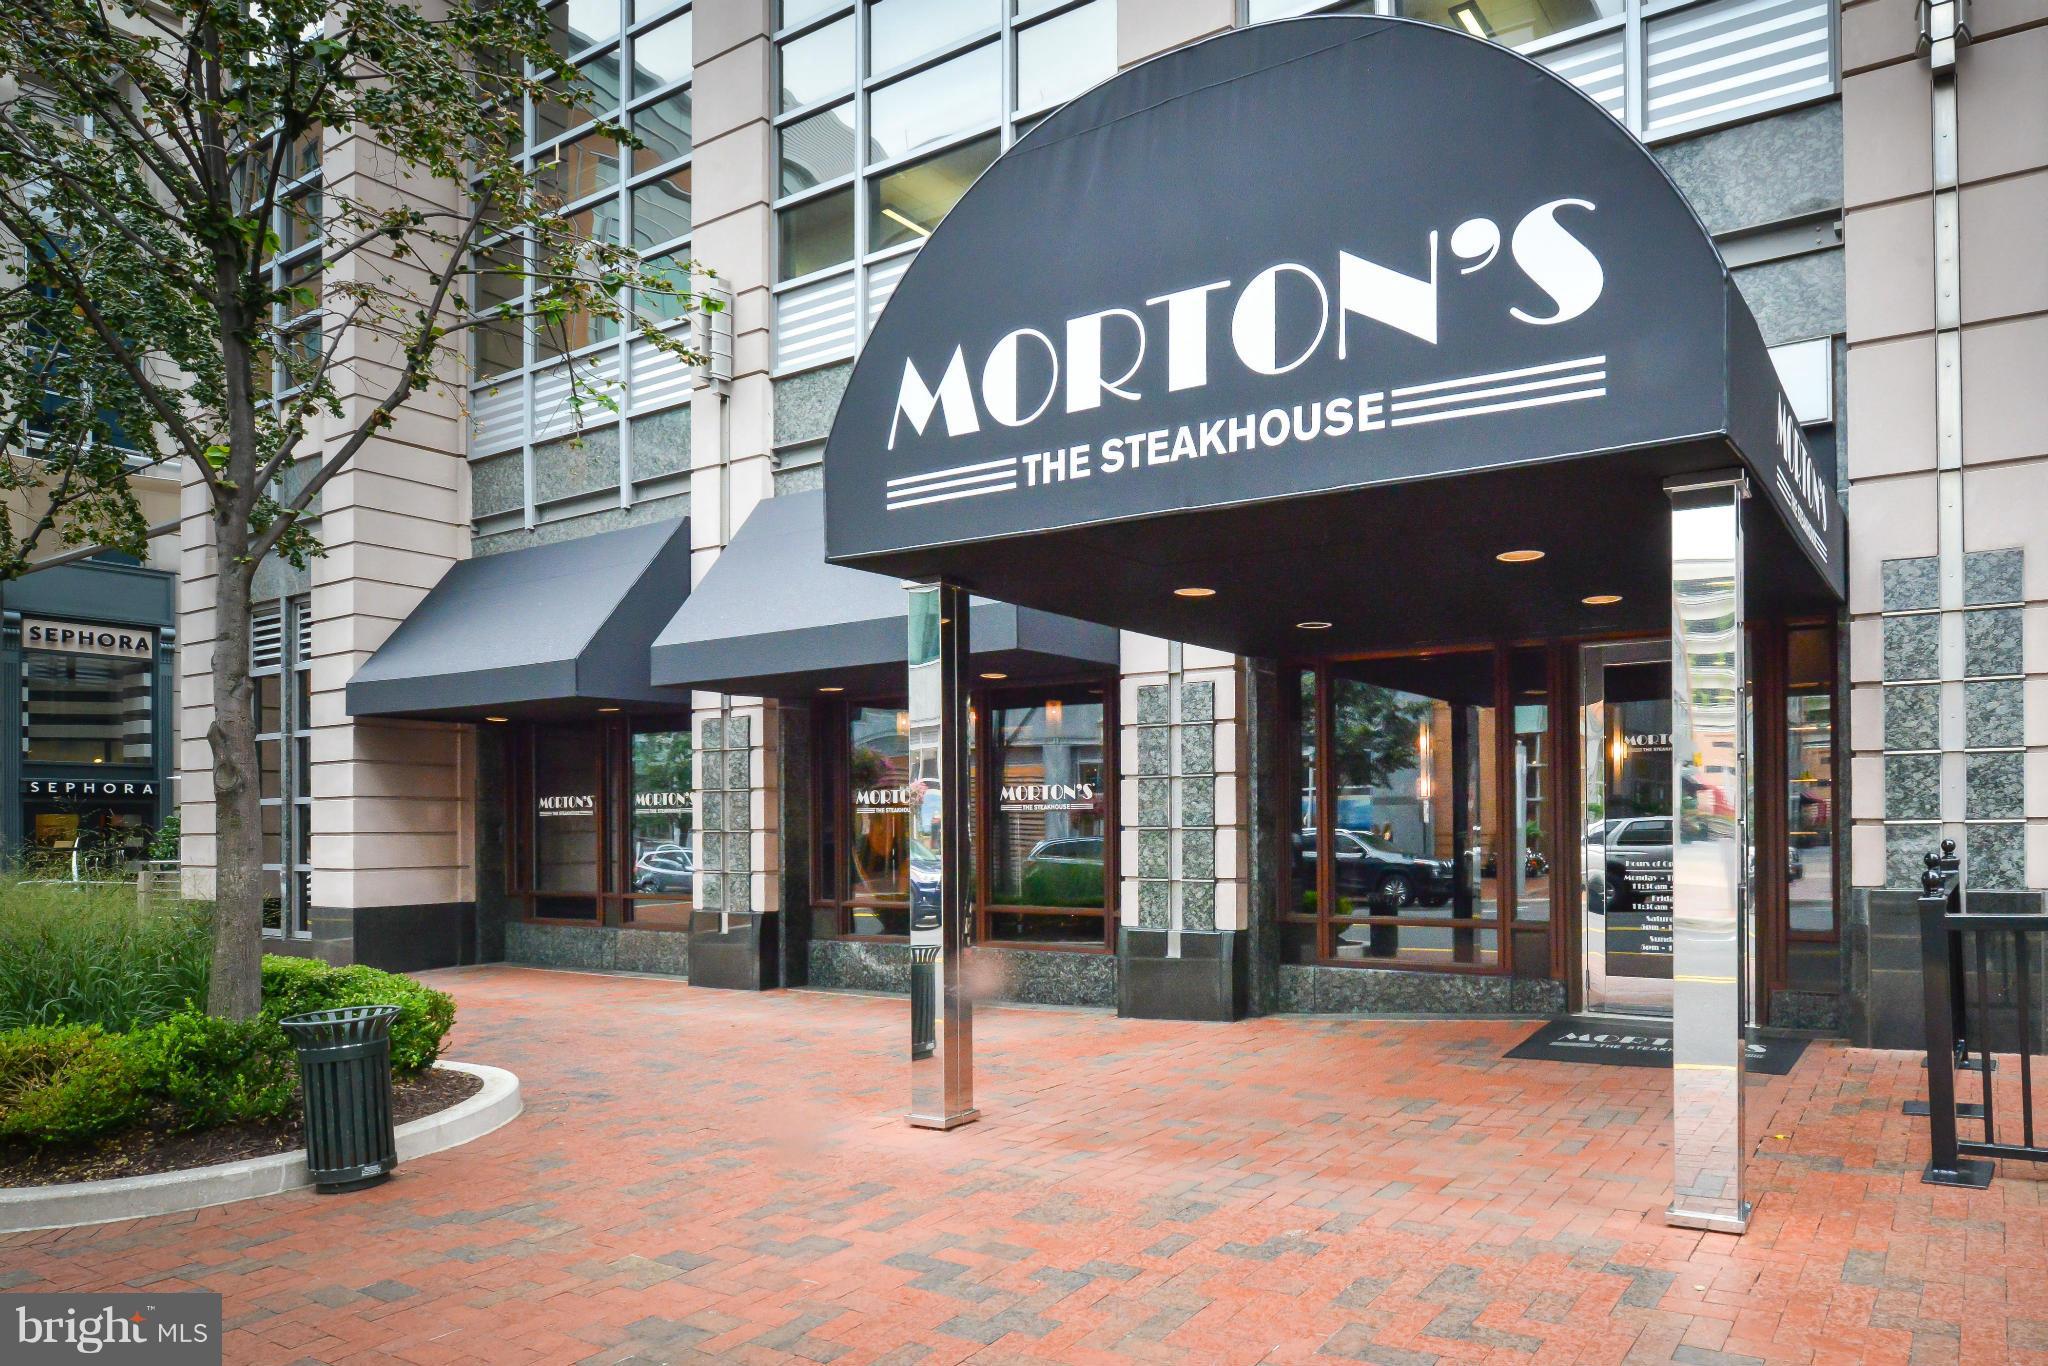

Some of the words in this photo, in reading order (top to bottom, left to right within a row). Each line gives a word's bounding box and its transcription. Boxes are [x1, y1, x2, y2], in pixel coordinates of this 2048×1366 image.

[887, 198, 1605, 451] MORTON'S
[1022, 450, 1091, 487] THE
[1100, 391, 1385, 473] STEAKHOUSE
[1776, 391, 1827, 532] MORTON'S
[29, 625, 150, 651] SEPHORA
[1624, 733, 1673, 746] MORT
[30, 781, 153, 795] SEPHORA
[1000, 783, 1093, 801] MORTON'S
[538, 795, 593, 809] MORTON'S
[856, 789, 911, 805] MORTO
[1033, 803, 1071, 811] STEAKHOUSE
